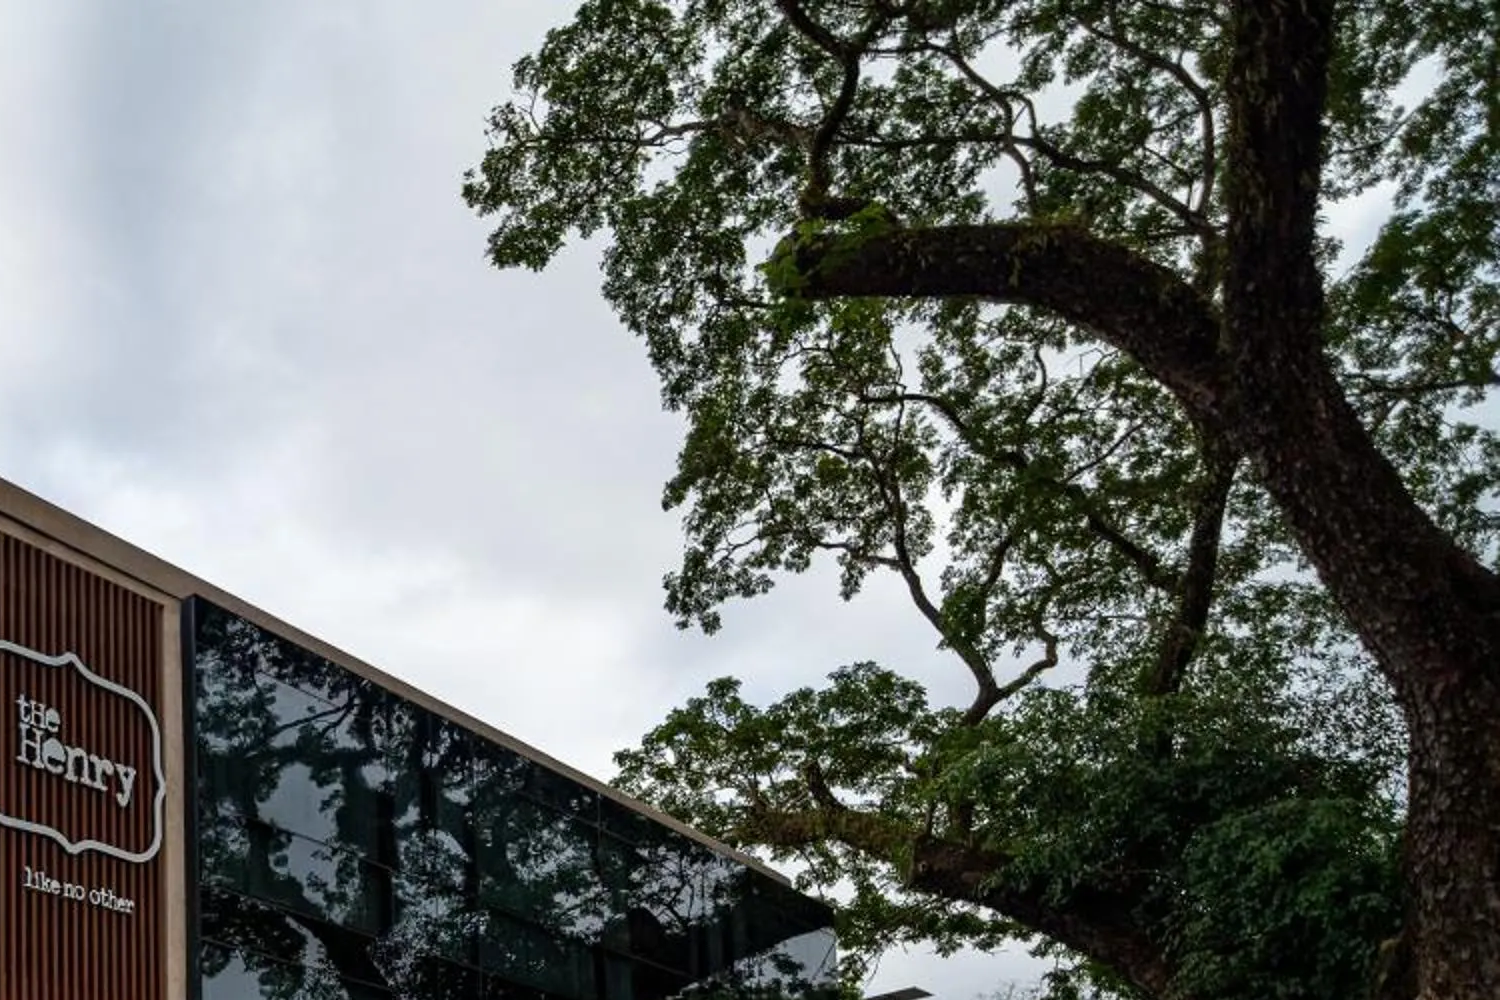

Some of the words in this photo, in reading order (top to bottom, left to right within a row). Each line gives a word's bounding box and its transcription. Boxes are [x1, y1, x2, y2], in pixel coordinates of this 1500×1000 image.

[16, 723, 136, 807] Henry
[23, 866, 61, 895] like
[63, 882, 86, 901] no
[89, 887, 135, 913] other
